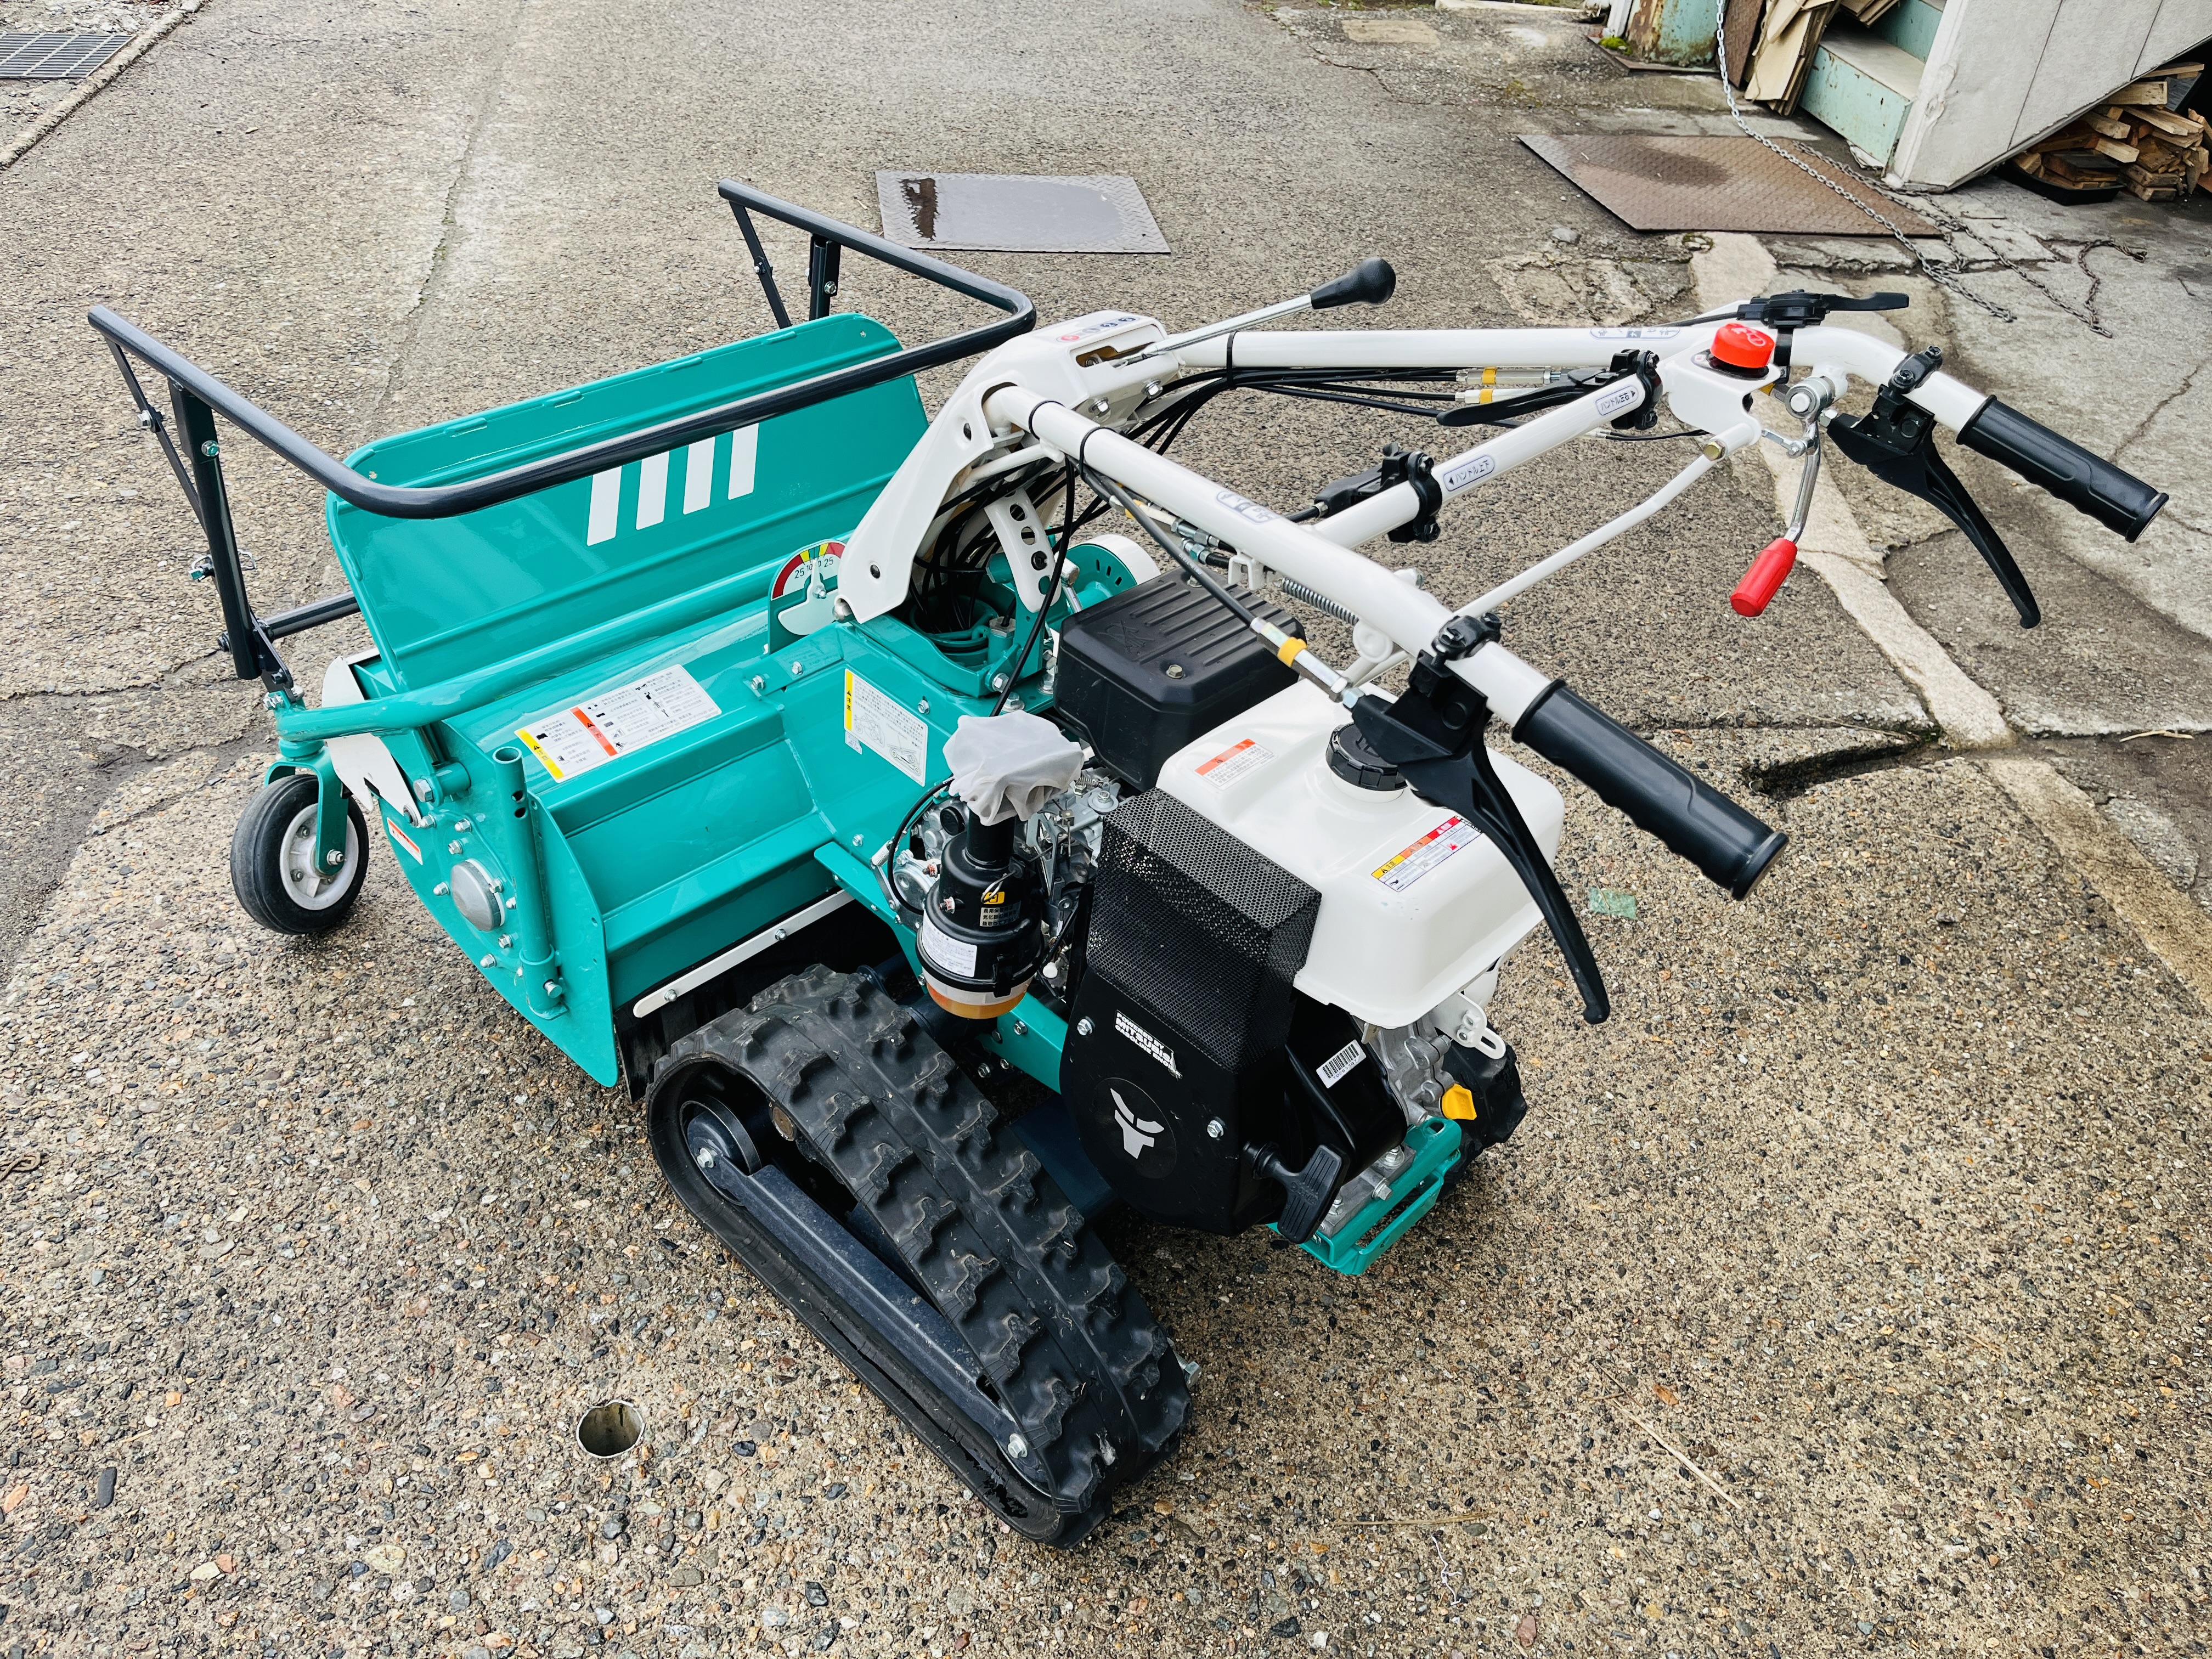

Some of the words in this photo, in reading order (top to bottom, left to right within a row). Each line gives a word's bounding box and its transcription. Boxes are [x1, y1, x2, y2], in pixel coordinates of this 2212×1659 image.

[1600, 392, 1630, 410] ハンドル左右
[1454, 459, 1489, 484] ハンドル上下
[794, 567, 805, 579] 25
[824, 556, 834, 568] 25
[1115, 1024, 1152, 1054] GASOLINE
[1116, 1012, 1153, 1042] POWERED
[1153, 1039, 1165, 1050] BY
